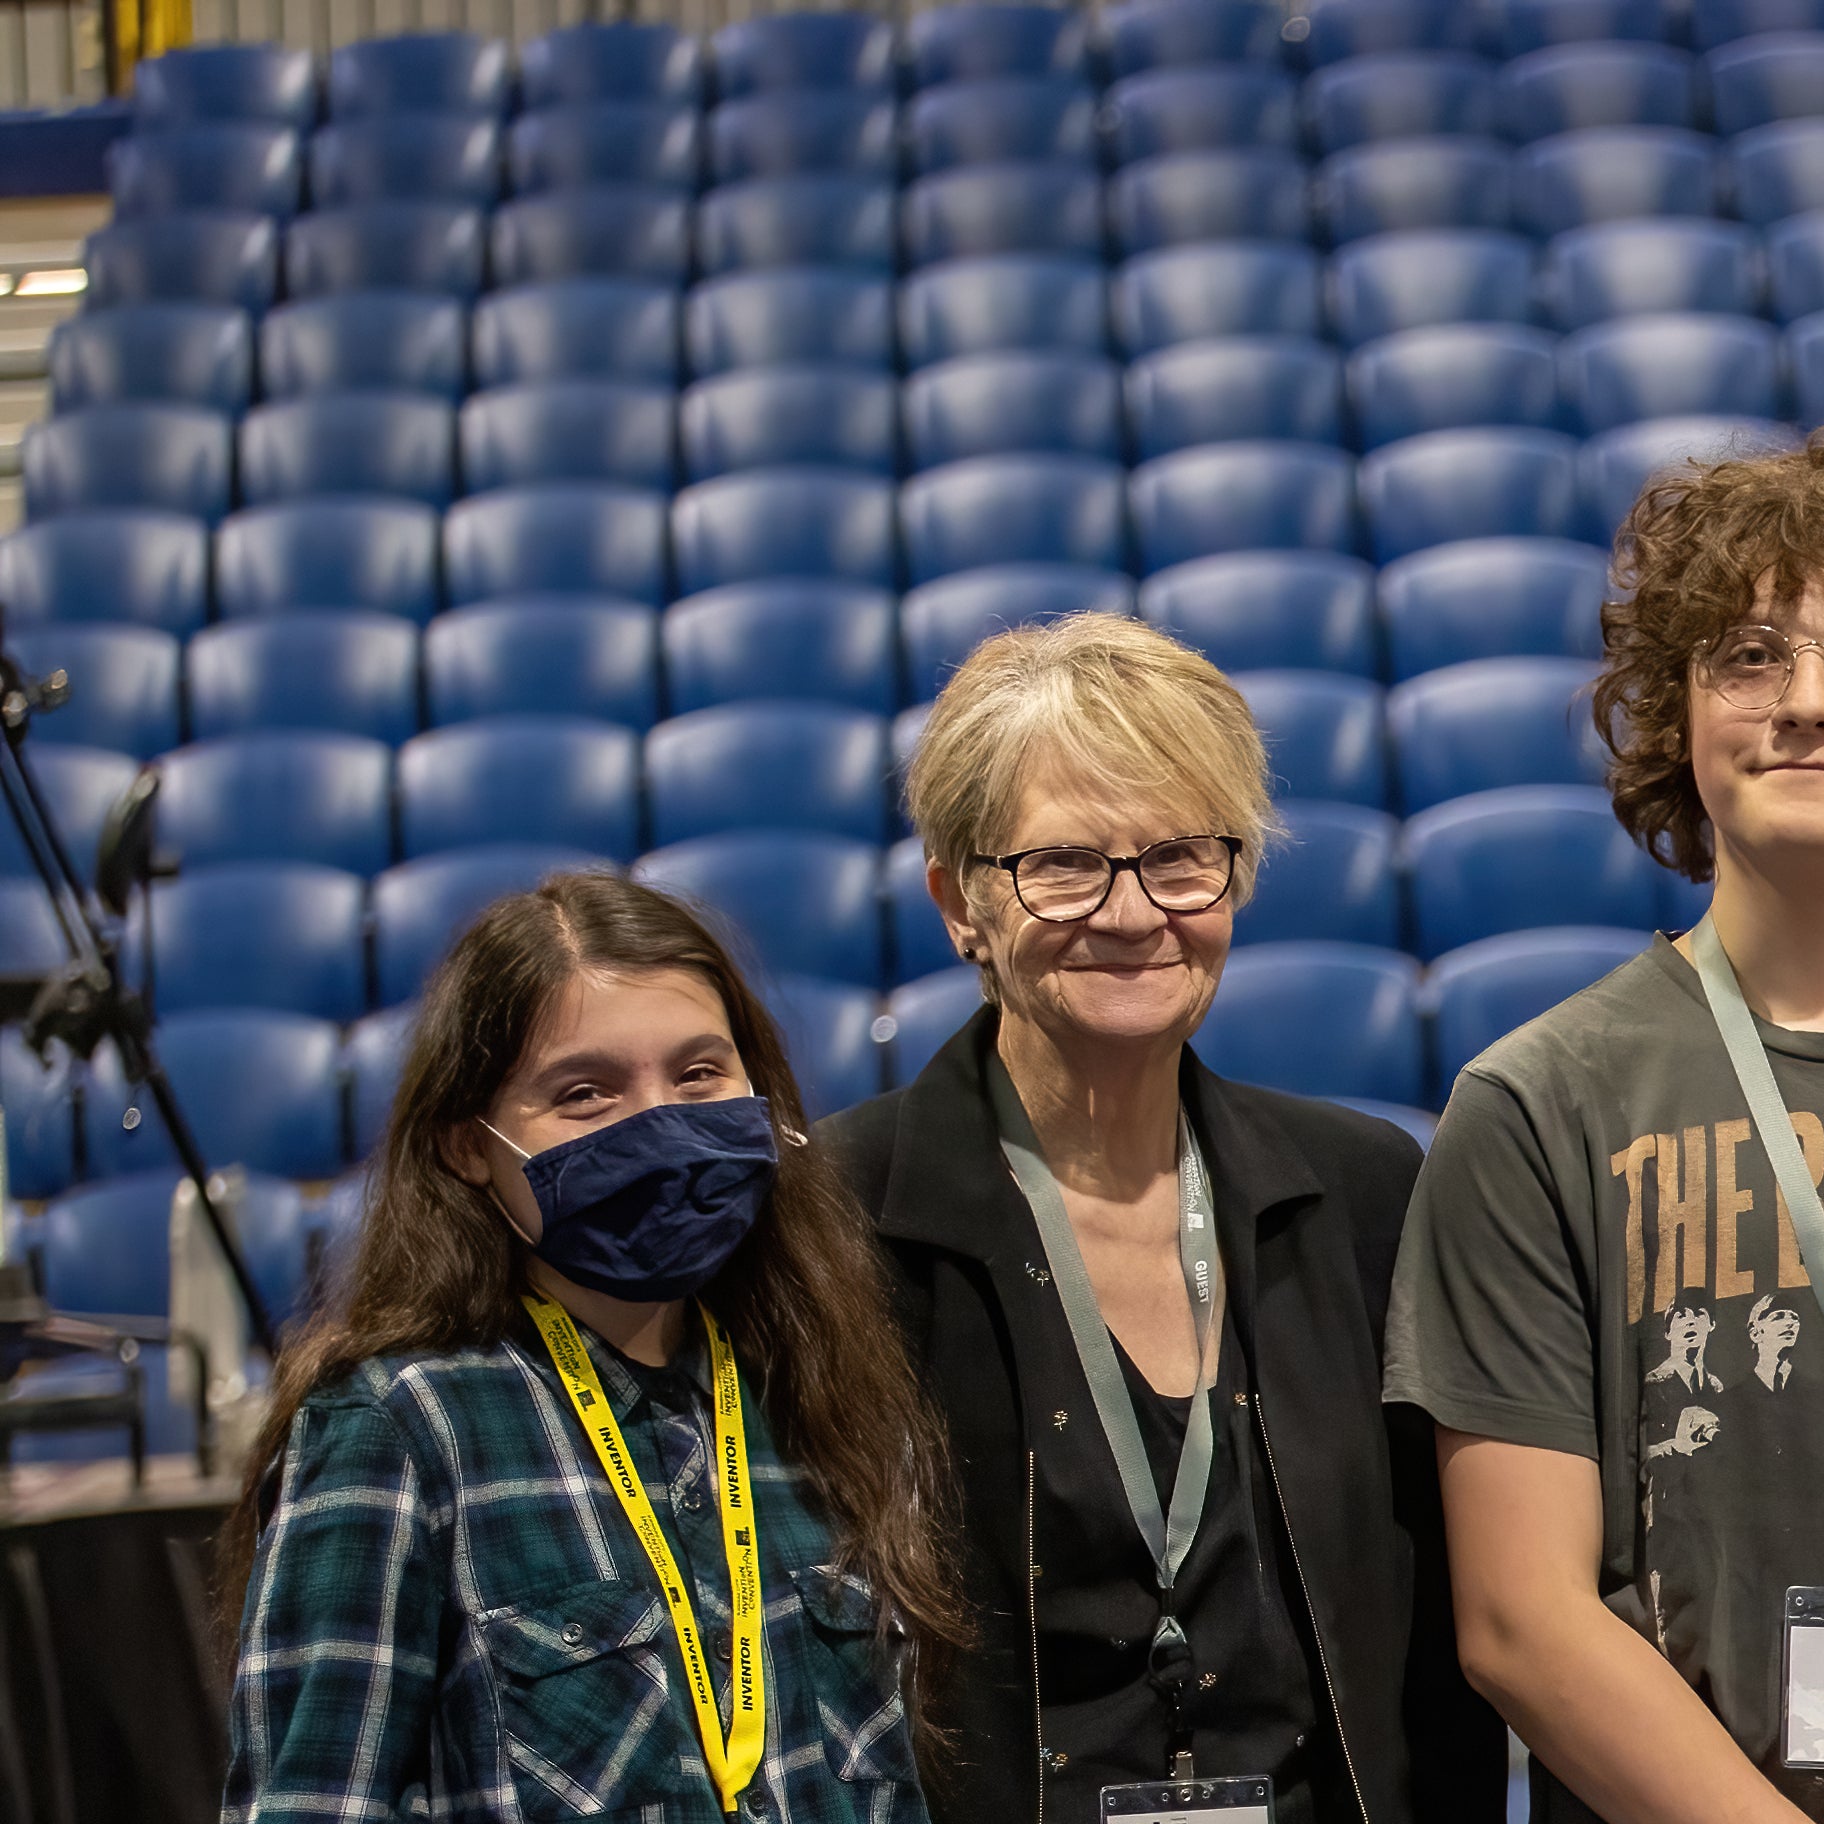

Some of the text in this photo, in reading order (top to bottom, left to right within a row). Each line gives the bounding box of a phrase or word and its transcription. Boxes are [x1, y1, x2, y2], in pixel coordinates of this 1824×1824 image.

[1610, 1117, 1755, 1324] THE
[1195, 1260, 1209, 1303] GUEST
[598, 1426, 637, 1498] INVENTOR
[725, 1435, 742, 1508] INVENTOR
[683, 1627, 709, 1705] INVENTOR
[740, 1636, 753, 1711] INVENTOR
